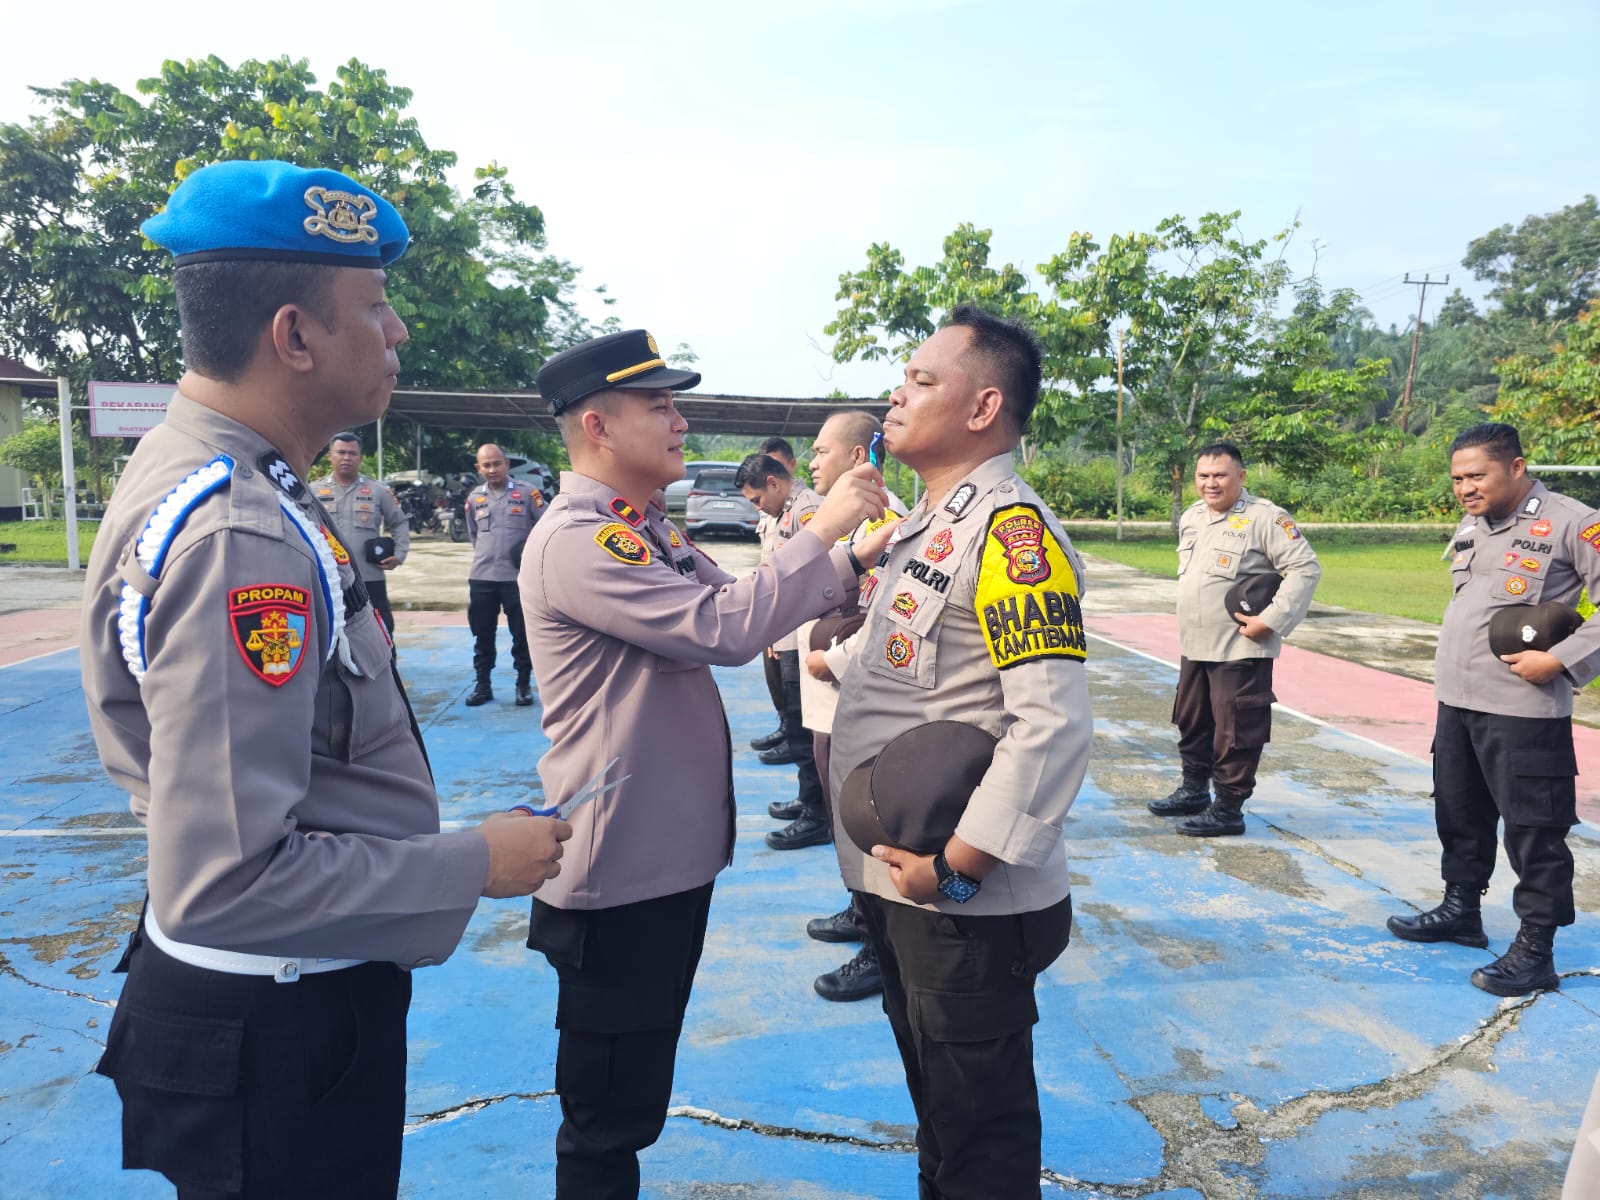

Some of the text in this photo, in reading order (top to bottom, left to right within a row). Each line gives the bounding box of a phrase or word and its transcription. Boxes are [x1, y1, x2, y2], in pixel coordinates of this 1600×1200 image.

[1222, 530, 1246, 540] POLRI
[1511, 539, 1552, 554] POLRI
[902, 557, 950, 594] POLRI
[237, 588, 303, 604] PROPAM
[984, 591, 1084, 642] BHABIN
